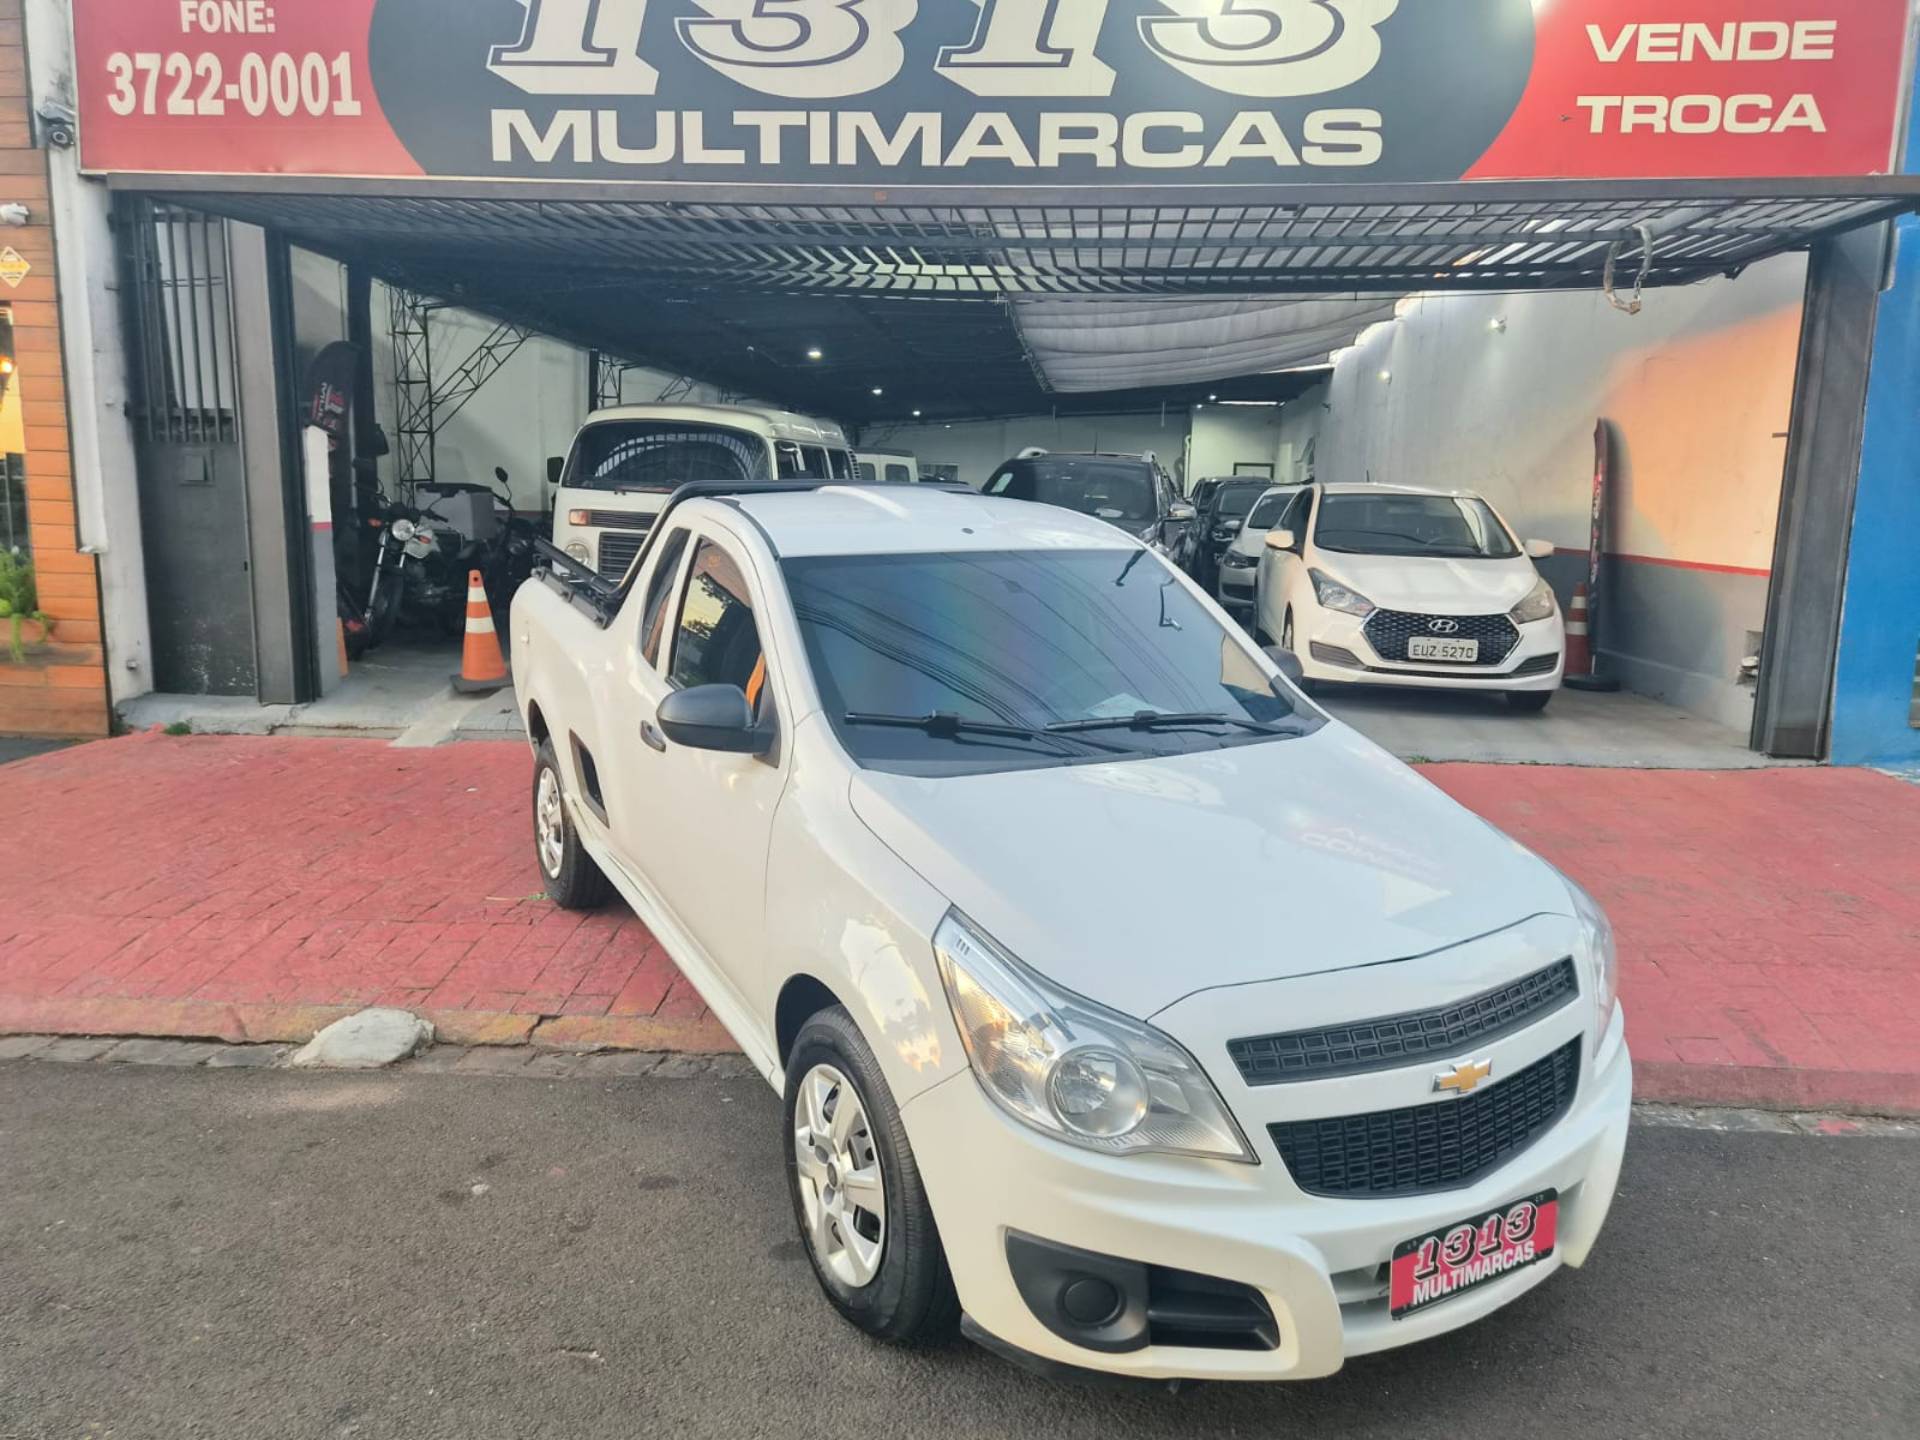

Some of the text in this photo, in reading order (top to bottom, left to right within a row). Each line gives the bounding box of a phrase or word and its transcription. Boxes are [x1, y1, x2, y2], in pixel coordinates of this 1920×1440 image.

[180, 0, 276, 33] FONE:
[1585, 20, 1837, 62] VENDE
[106, 51, 362, 117] 3722-0001
[490, 108, 1383, 168] MULTIMARCAS
[1576, 93, 1827, 134] TROCA
[1413, 644, 1474, 659] EUZ 5270
[1413, 1201, 1538, 1283] 1313
[1412, 1240, 1536, 1305] MULTIMARCAS
